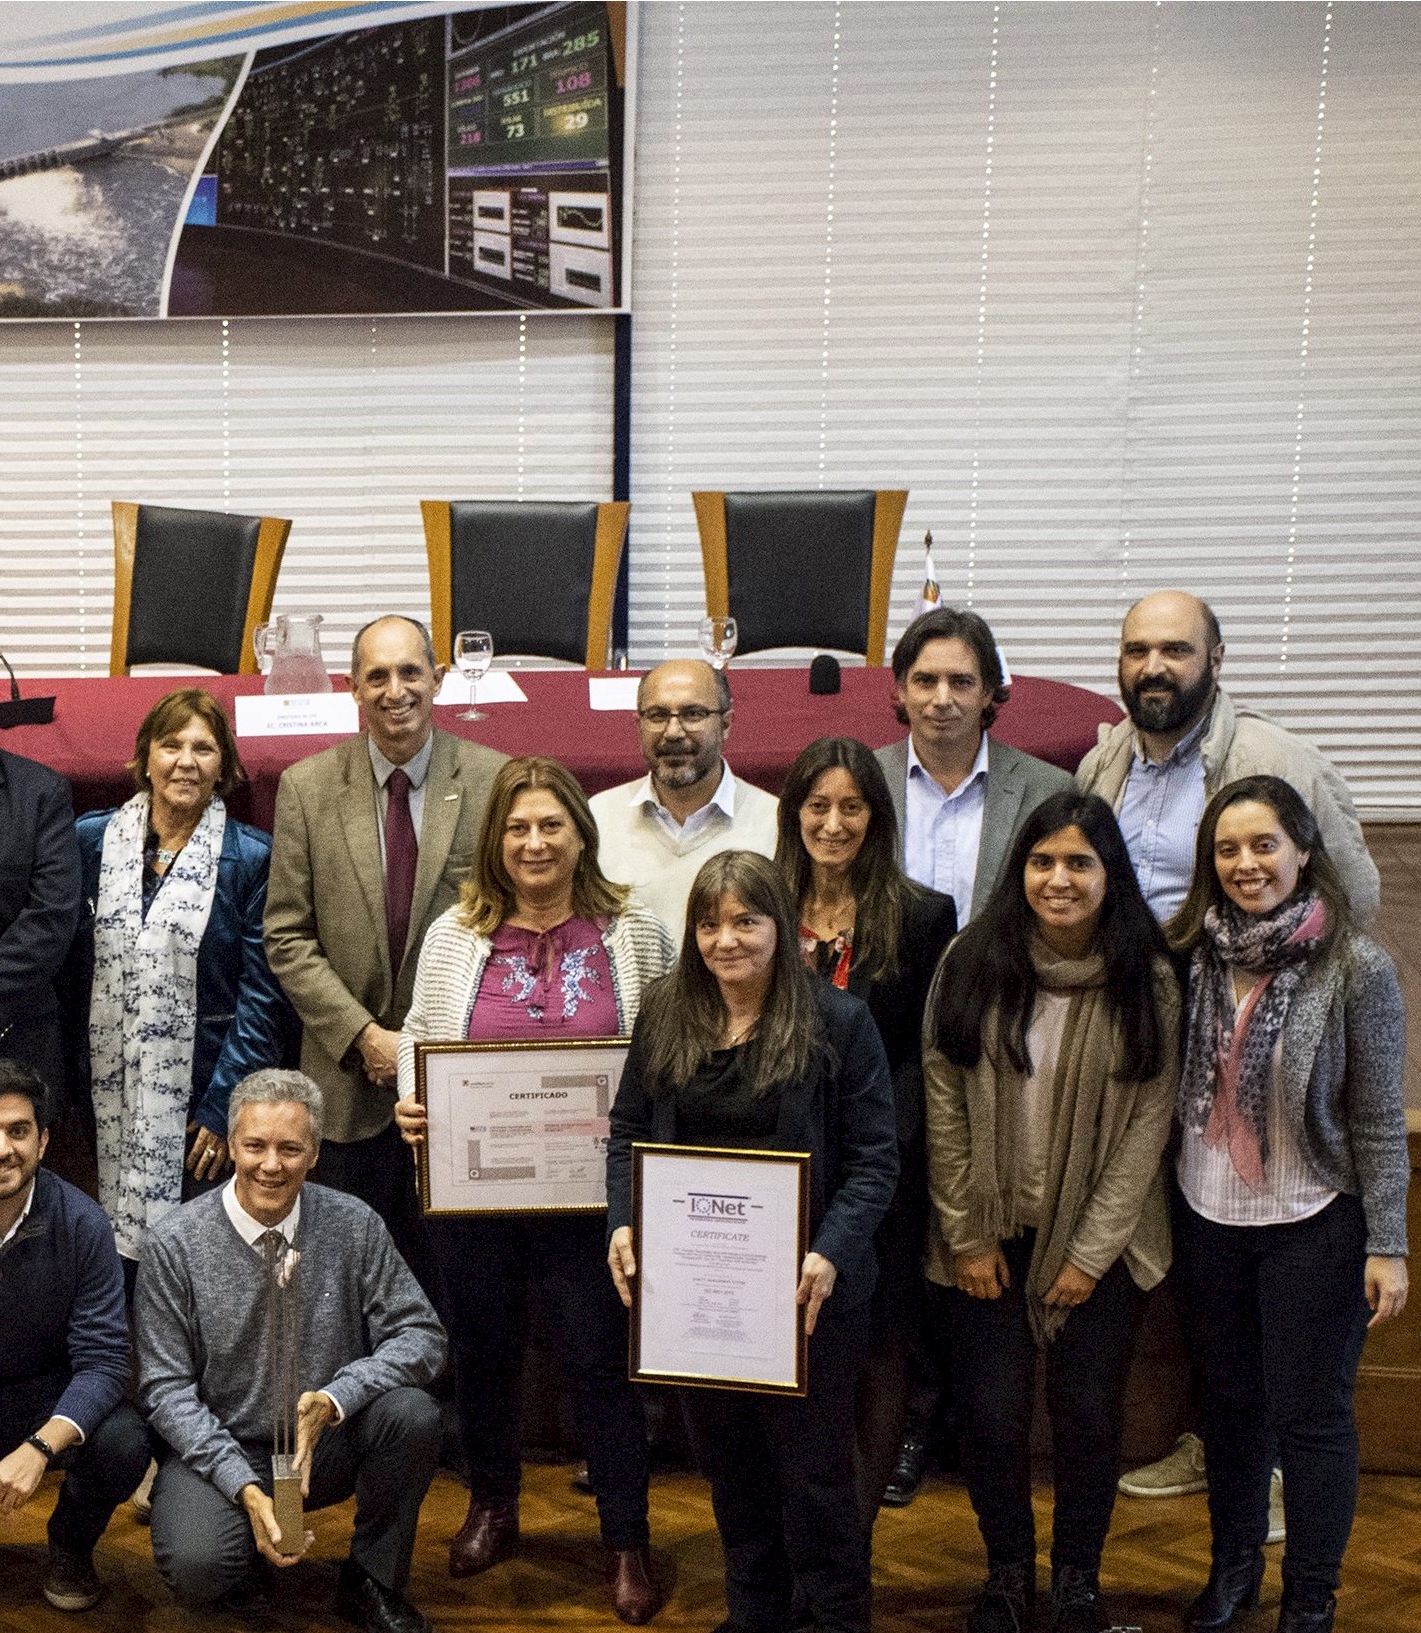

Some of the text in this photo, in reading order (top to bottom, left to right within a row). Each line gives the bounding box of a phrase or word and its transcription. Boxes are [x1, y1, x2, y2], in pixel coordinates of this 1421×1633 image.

[562, 29, 600, 56] 285
[511, 54, 538, 75] 171
[556, 72, 591, 94] 108
[503, 89, 529, 107] 551
[564, 112, 589, 130] 29
[507, 123, 525, 139] 73
[509, 1091, 568, 1100] CERTIFICADO
[691, 1197, 746, 1217] IQNet
[690, 1230, 749, 1242] CERTIFICATE
